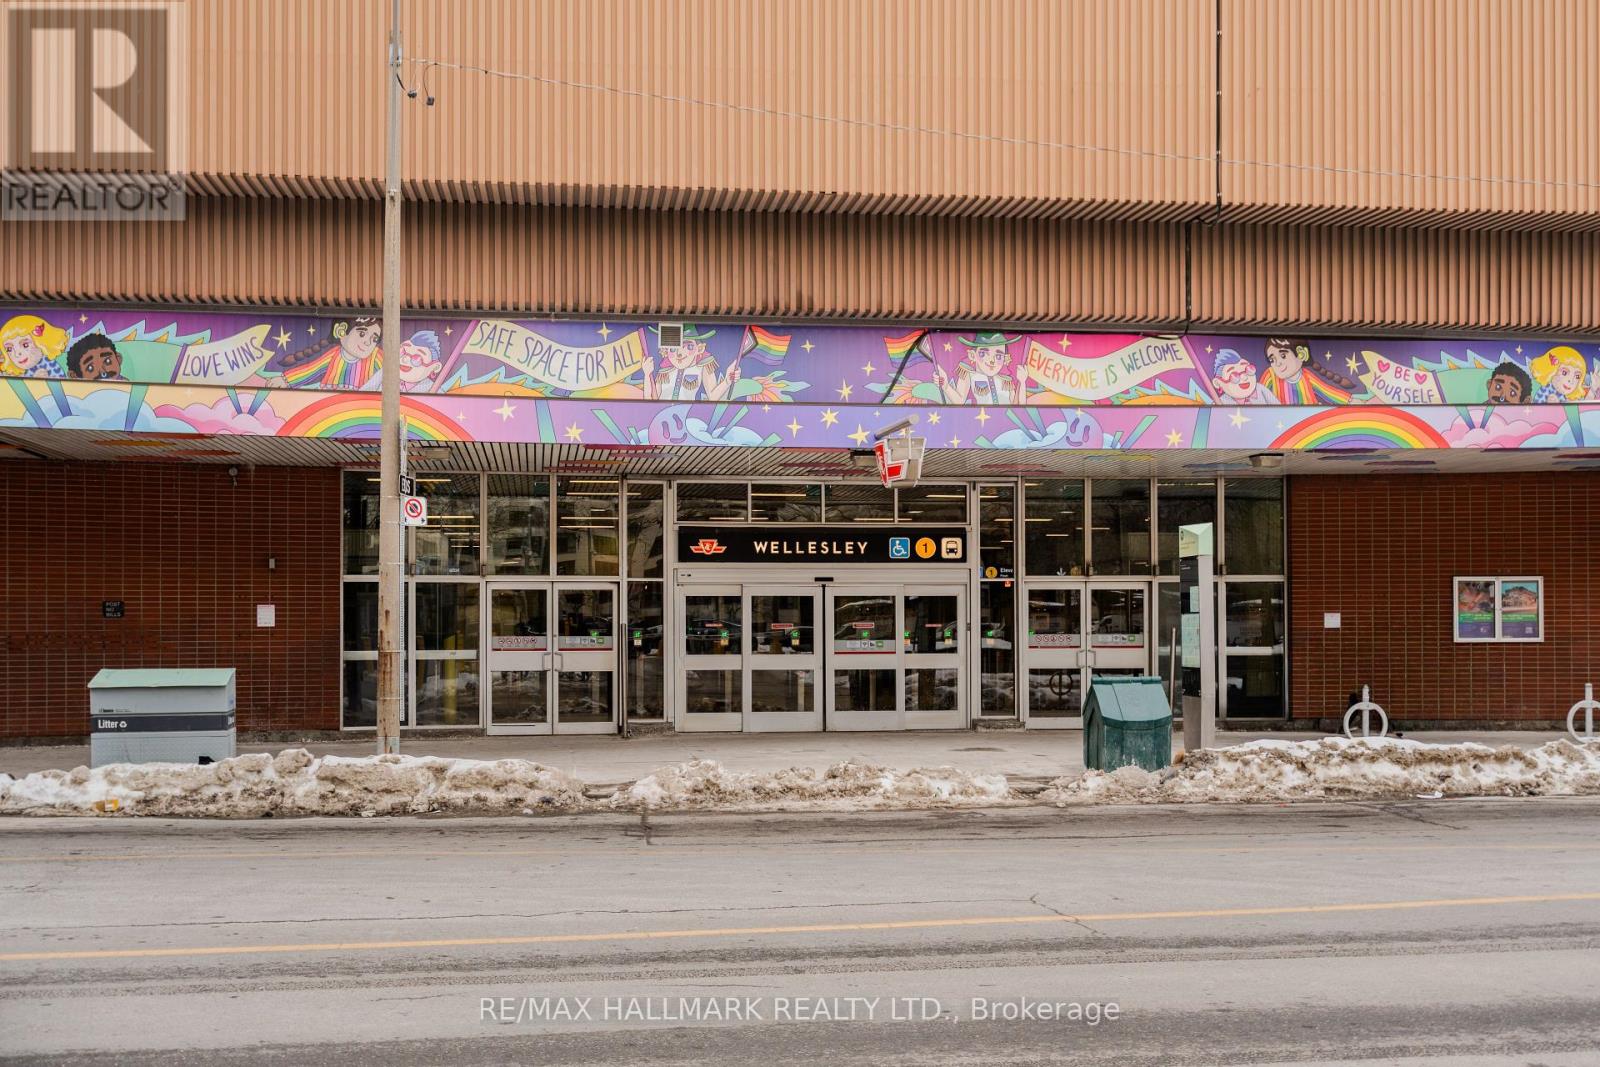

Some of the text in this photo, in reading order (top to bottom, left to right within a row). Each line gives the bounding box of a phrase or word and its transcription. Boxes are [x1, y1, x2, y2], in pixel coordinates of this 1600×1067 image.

[182, 336, 265, 378] LOVE WINS
[470, 321, 641, 385] SAFE SPACE FOR ALL
[1028, 342, 1183, 390] EVERYONE IS WELCOME
[1371, 371, 1435, 404] YOURSELF
[1394, 366, 1411, 382] BE
[753, 541, 868, 555] WELLESLEY
[98, 719, 119, 729] Litter
